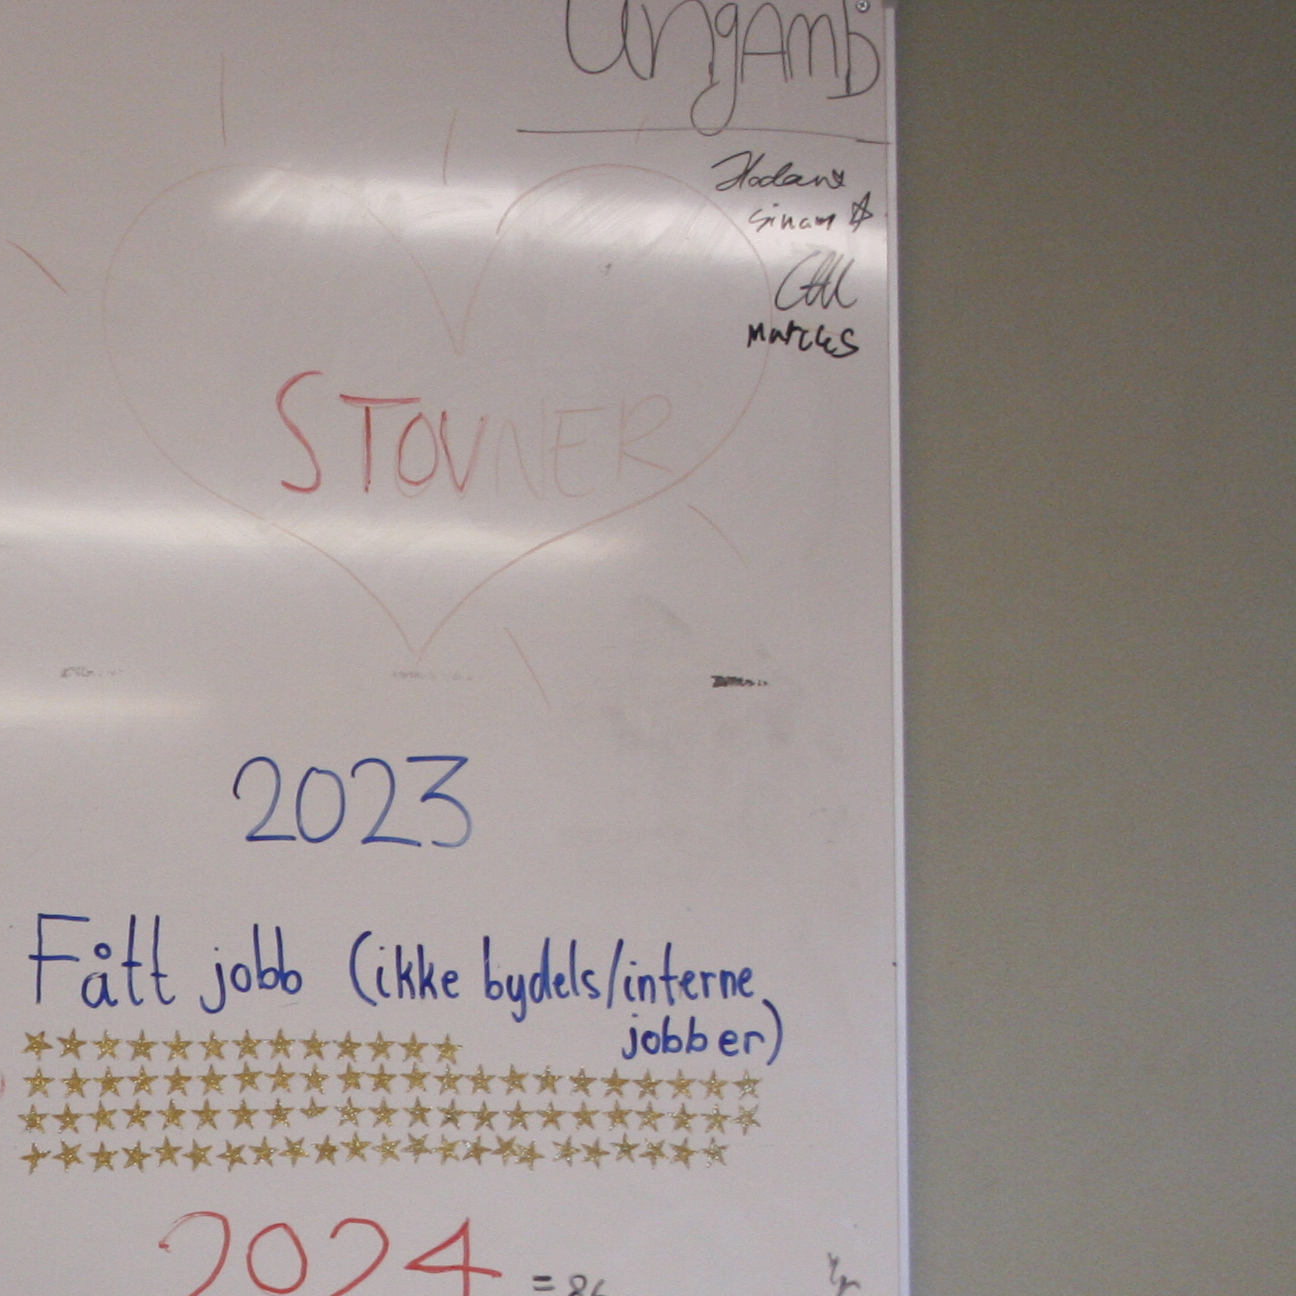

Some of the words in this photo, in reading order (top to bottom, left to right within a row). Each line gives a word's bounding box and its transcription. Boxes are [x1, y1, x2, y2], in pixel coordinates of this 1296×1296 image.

[276, 370, 676, 499] STOVNER
[234, 756, 473, 848] 2023
[27, 913, 176, 1008] Fått
[200, 923, 305, 1014] jobb
[347, 930, 461, 1006] (ikke
